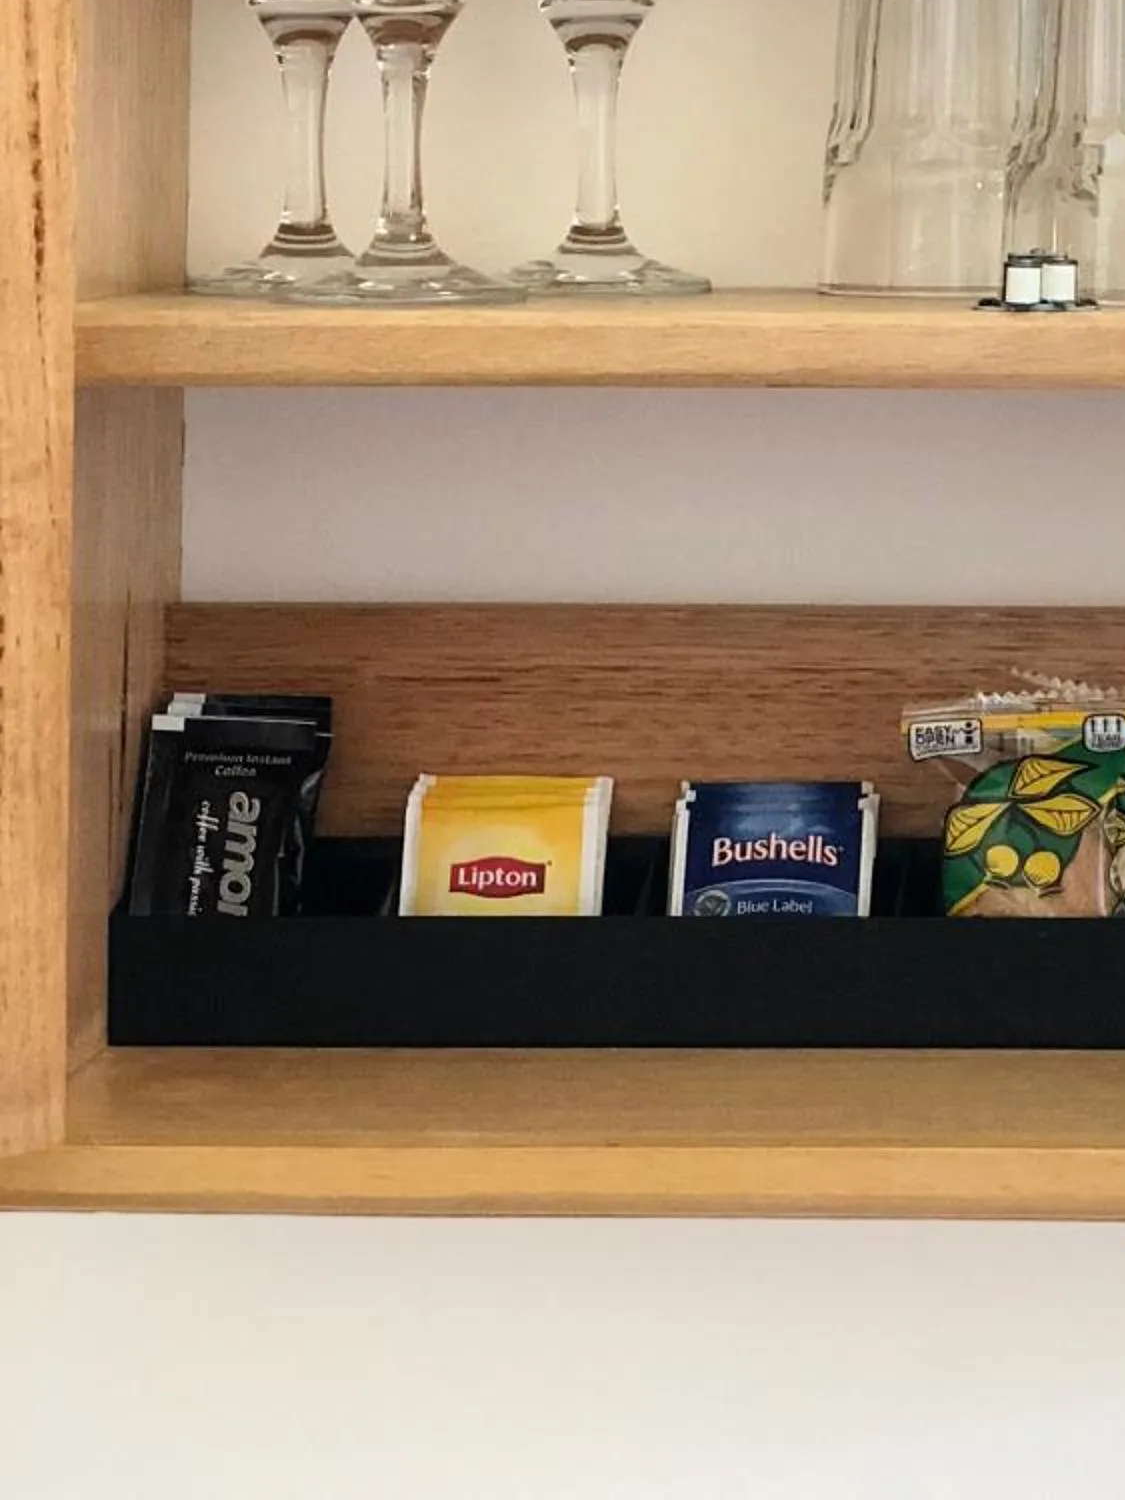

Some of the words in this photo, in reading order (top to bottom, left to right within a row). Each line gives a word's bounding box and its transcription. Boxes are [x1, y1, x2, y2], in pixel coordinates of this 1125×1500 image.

[916, 724, 952, 735] EASY
[915, 732, 955, 745] OPEN
[184, 750, 243, 764] Premium
[245, 753, 292, 765] Instant
[214, 764, 257, 777] Coffee
[195, 800, 220, 842] coffee
[711, 831, 839, 867] Bushells
[193, 845, 215, 875] with
[457, 866, 537, 890] Lipton
[737, 900, 770, 914] Blue
[772, 899, 813, 914] Label
